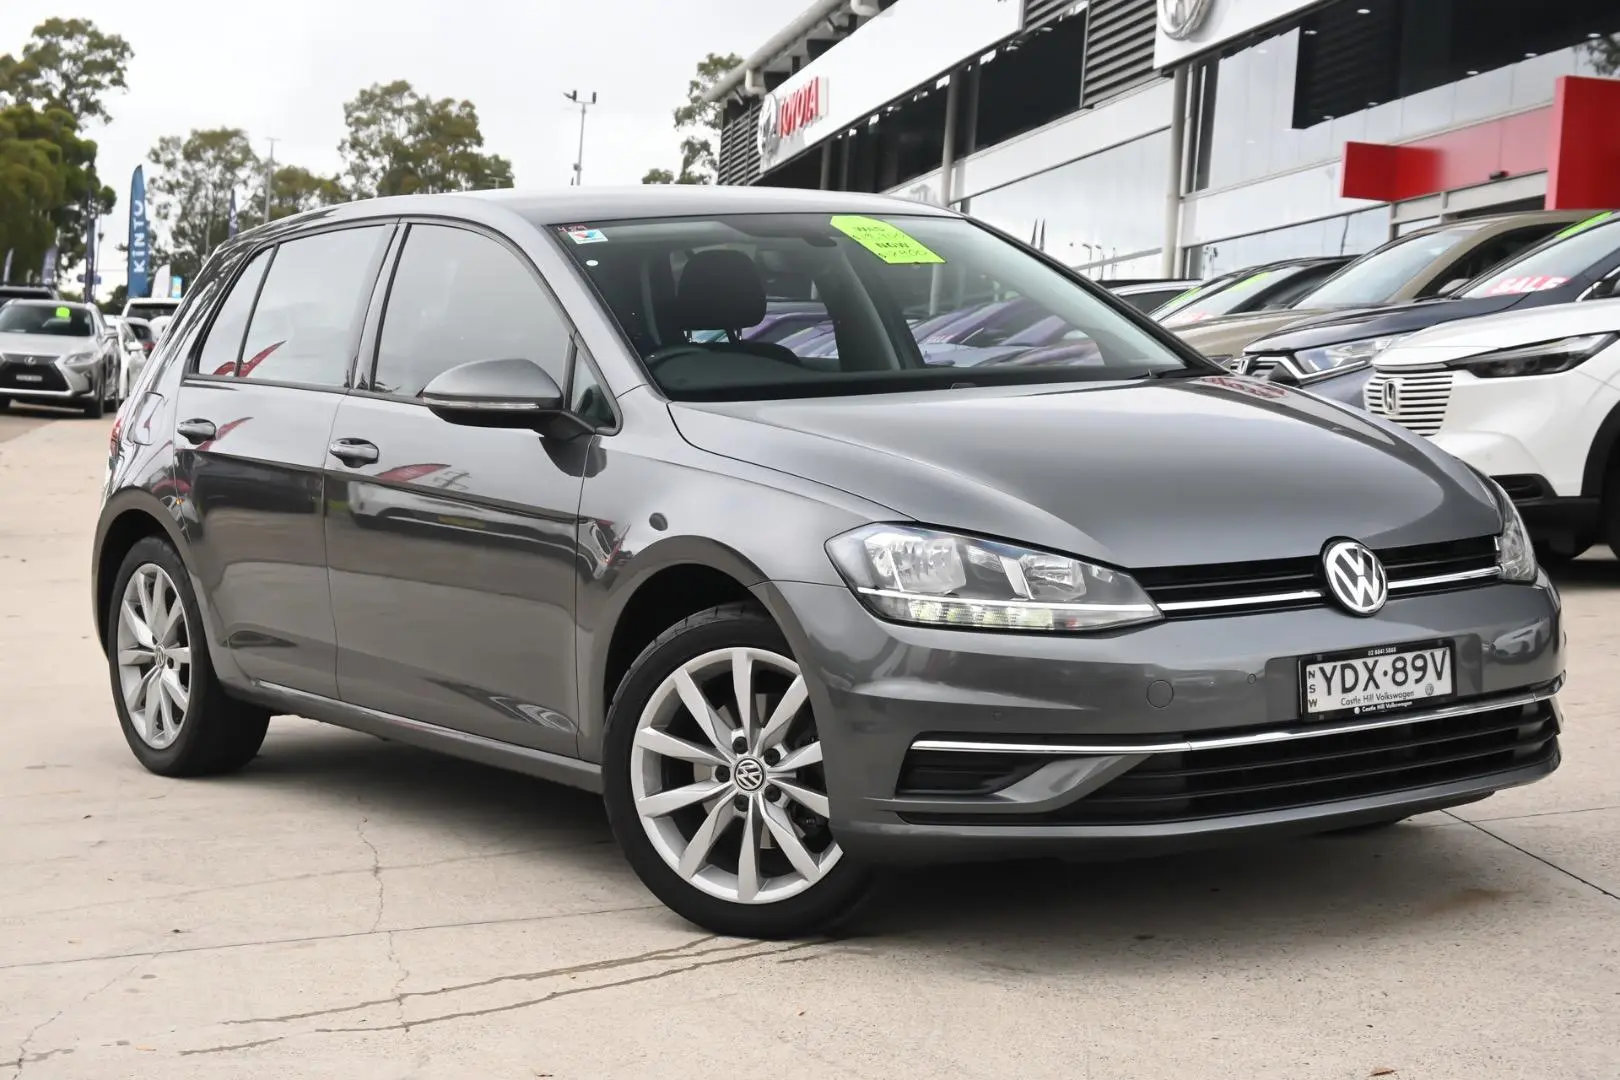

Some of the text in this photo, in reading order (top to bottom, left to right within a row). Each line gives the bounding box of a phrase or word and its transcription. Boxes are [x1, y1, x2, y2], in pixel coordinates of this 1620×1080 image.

[1341, 690, 1414, 706] Castle Hill Volkswagen
